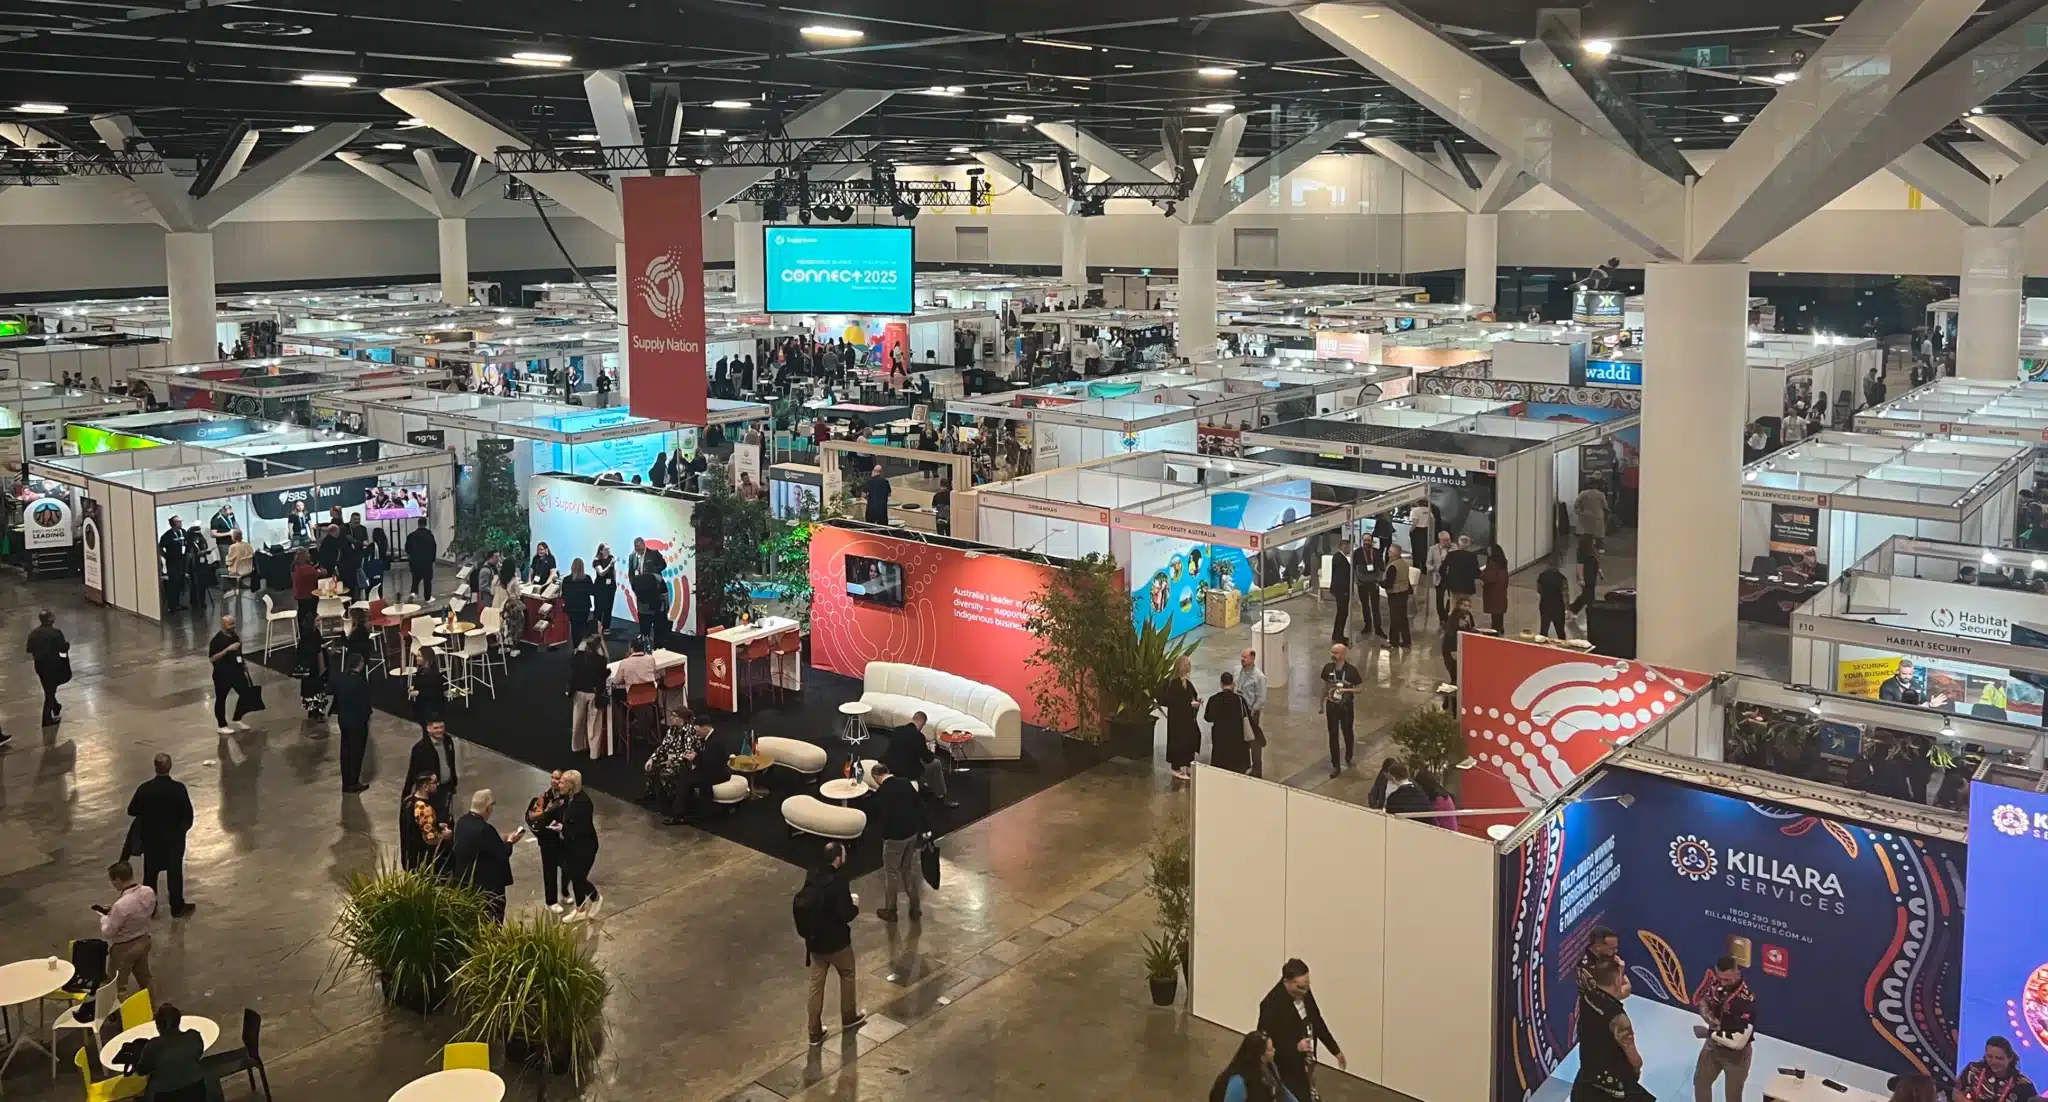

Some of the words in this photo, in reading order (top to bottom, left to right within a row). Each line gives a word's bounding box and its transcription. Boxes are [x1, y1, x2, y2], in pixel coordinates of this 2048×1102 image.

[863, 270, 898, 283] 2025
[632, 335, 665, 353] Supply
[666, 337, 699, 353] Nation
[1585, 364, 1631, 381] waddi
[1412, 474, 1467, 487] INDIGENOUS
[287, 491, 308, 502] SBS
[320, 485, 341, 497] NITV
[1762, 492, 1791, 500] SERVICES
[1792, 494, 1815, 502] GROUP
[555, 496, 580, 514] Supply
[581, 501, 608, 517] Nation
[32, 531, 66, 540] LEADING
[1152, 522, 1187, 534] BIODIVERSITY
[1187, 527, 1216, 538] AUSTRALIA
[953, 586, 989, 602] Australia's
[990, 593, 1013, 607] leader
[953, 598, 984, 613] diversity
[953, 609, 994, 625] Indigenous
[1959, 611, 2008, 628] Habitat
[1799, 622, 1814, 632] F10
[1959, 623, 2008, 639] Security
[1886, 636, 1925, 649] HABITAT
[1927, 641, 1972, 655] SECURITY
[1843, 671, 1863, 679] YOUR
[1864, 670, 1897, 678] BUSINES
[1853, 662, 1889, 671] SECURING
[1560, 853, 1595, 897] MULTI-AWARD
[1594, 834, 1615, 865] WINNING
[1727, 848, 1845, 898] KILLARA
[1559, 881, 1590, 915] ABORIGINAL
[1589, 853, 1614, 881] CLEANING
[1559, 916, 1564, 933] &
[1564, 884, 1599, 929] MAINTENANCE
[1599, 863, 1621, 896] PARTNER
[1725, 874, 1845, 915] SERVICES
[1704, 909, 1813, 944] KILLARASERVICES.COM.AU
[1729, 907, 1750, 919] 1800
[1752, 913, 1769, 924] 290
[1771, 919, 1788, 929] 599
